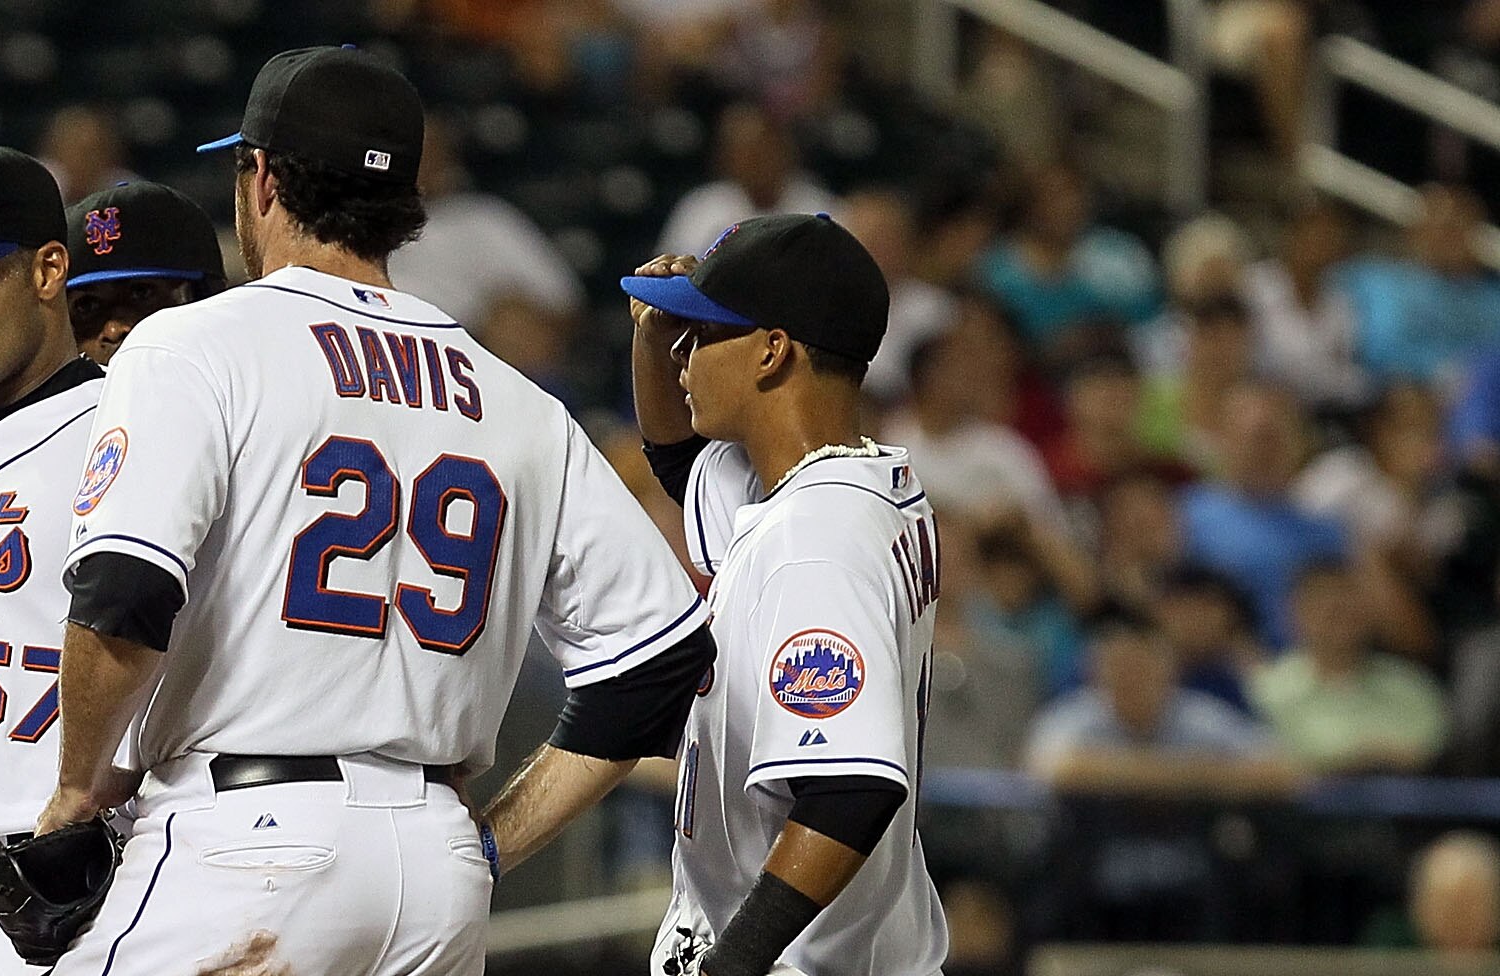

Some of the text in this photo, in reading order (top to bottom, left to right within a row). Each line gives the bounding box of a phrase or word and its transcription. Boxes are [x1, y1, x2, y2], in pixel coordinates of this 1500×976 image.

[309, 322, 484, 421] DAVIS
[281, 435, 508, 655] 29
[784, 667, 846, 693] Mets
